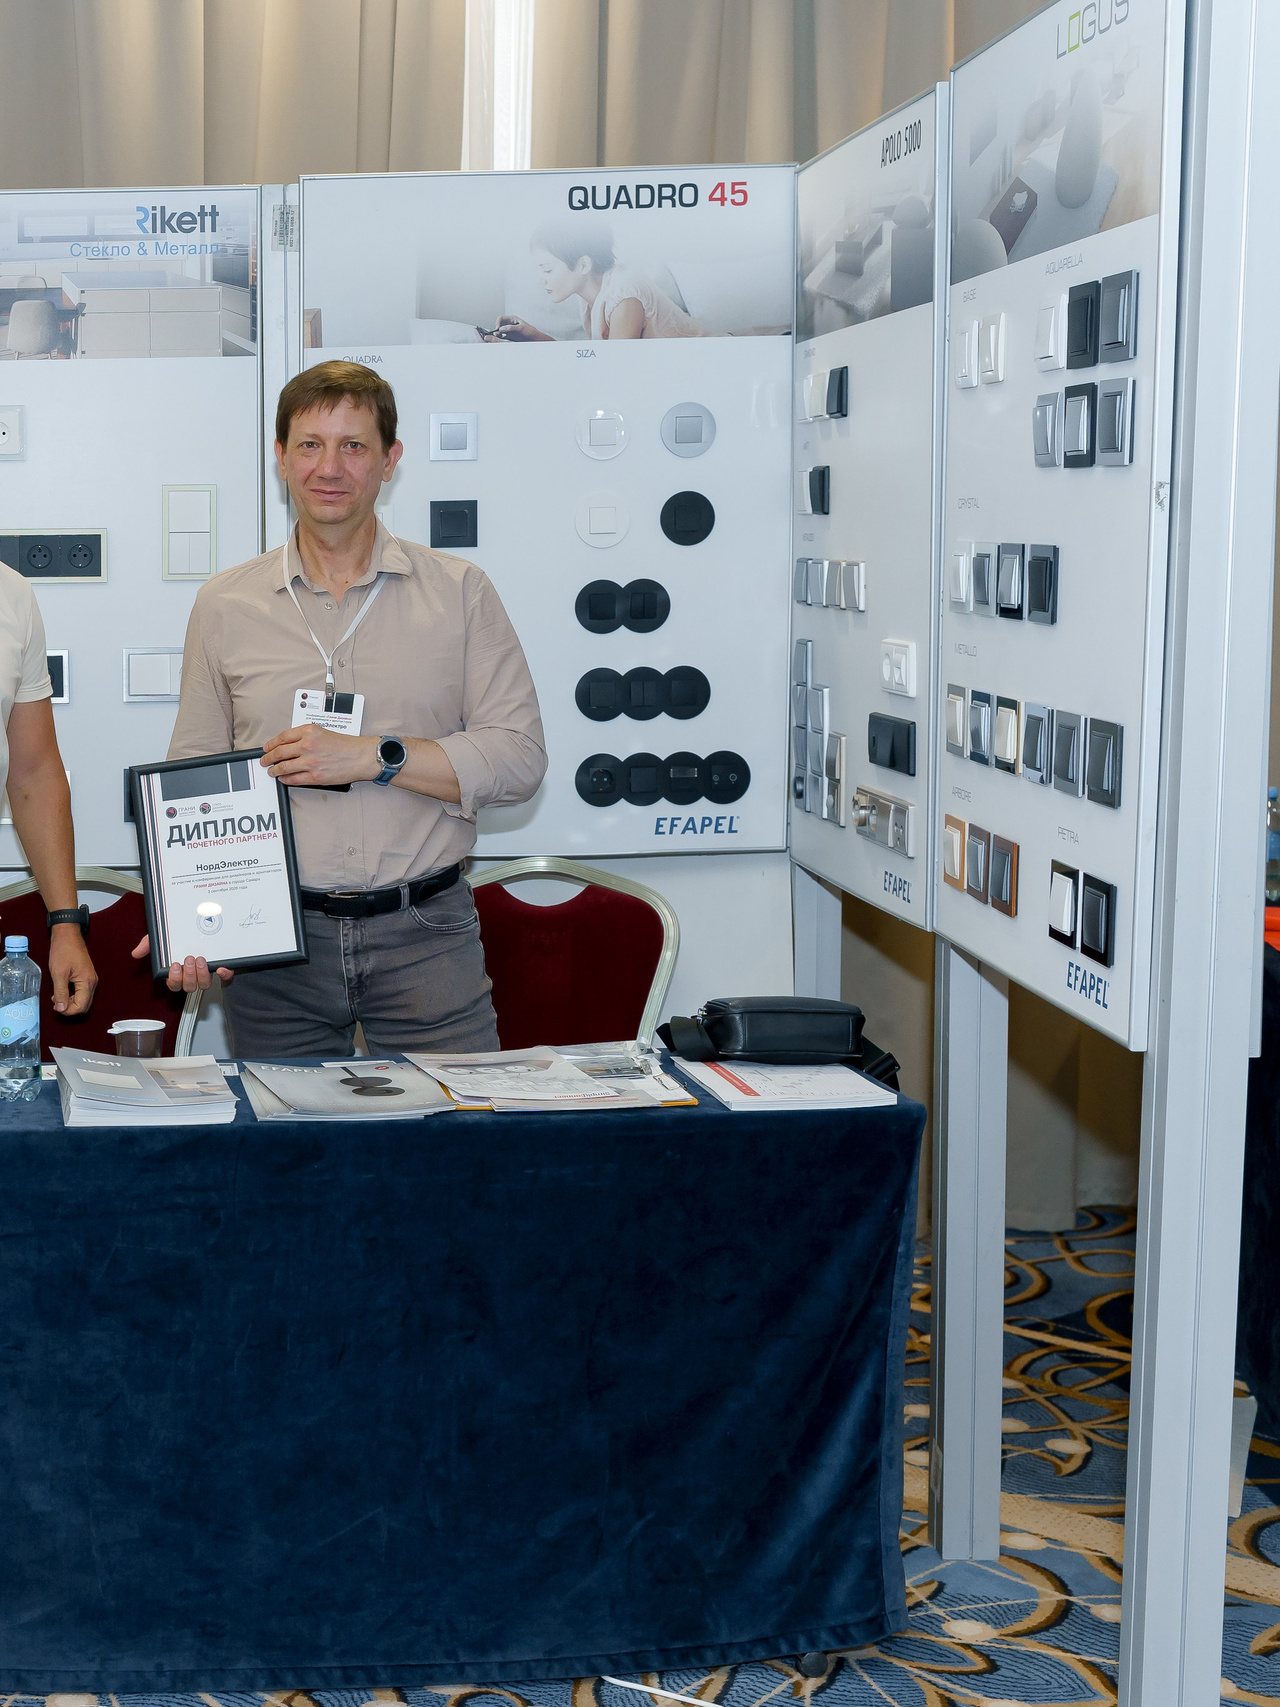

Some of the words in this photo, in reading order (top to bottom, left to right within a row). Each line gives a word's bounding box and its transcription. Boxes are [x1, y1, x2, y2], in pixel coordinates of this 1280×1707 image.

[880, 131, 901, 168] APOLO
[904, 119, 921, 156] 5000
[568, 183, 699, 210] QUADRO
[708, 182, 748, 207] 45
[136, 205, 219, 234] Rikett
[70, 242, 131, 257] Стекло
[137, 242, 148, 256] &
[155, 241, 220, 256] Металл
[1044, 253, 1084, 276] AQUARELLA
[576, 349, 596, 359] SIZA
[167, 813, 277, 848] ДИПЛОМ
[654, 816, 739, 835] EFAPEL
[187, 837, 235, 849] ПОЧЕТНОГО
[236, 832, 278, 843] ПАРТНЕРА
[1057, 826, 1079, 845] PETRA
[196, 858, 259, 872] НордЭлектро
[883, 871, 911, 904] EFAPEL
[1067, 961, 1109, 1009] EFAPEL
[4, 1006, 35, 1021] AQUA
[260, 1065, 323, 1074] EFAPEL
